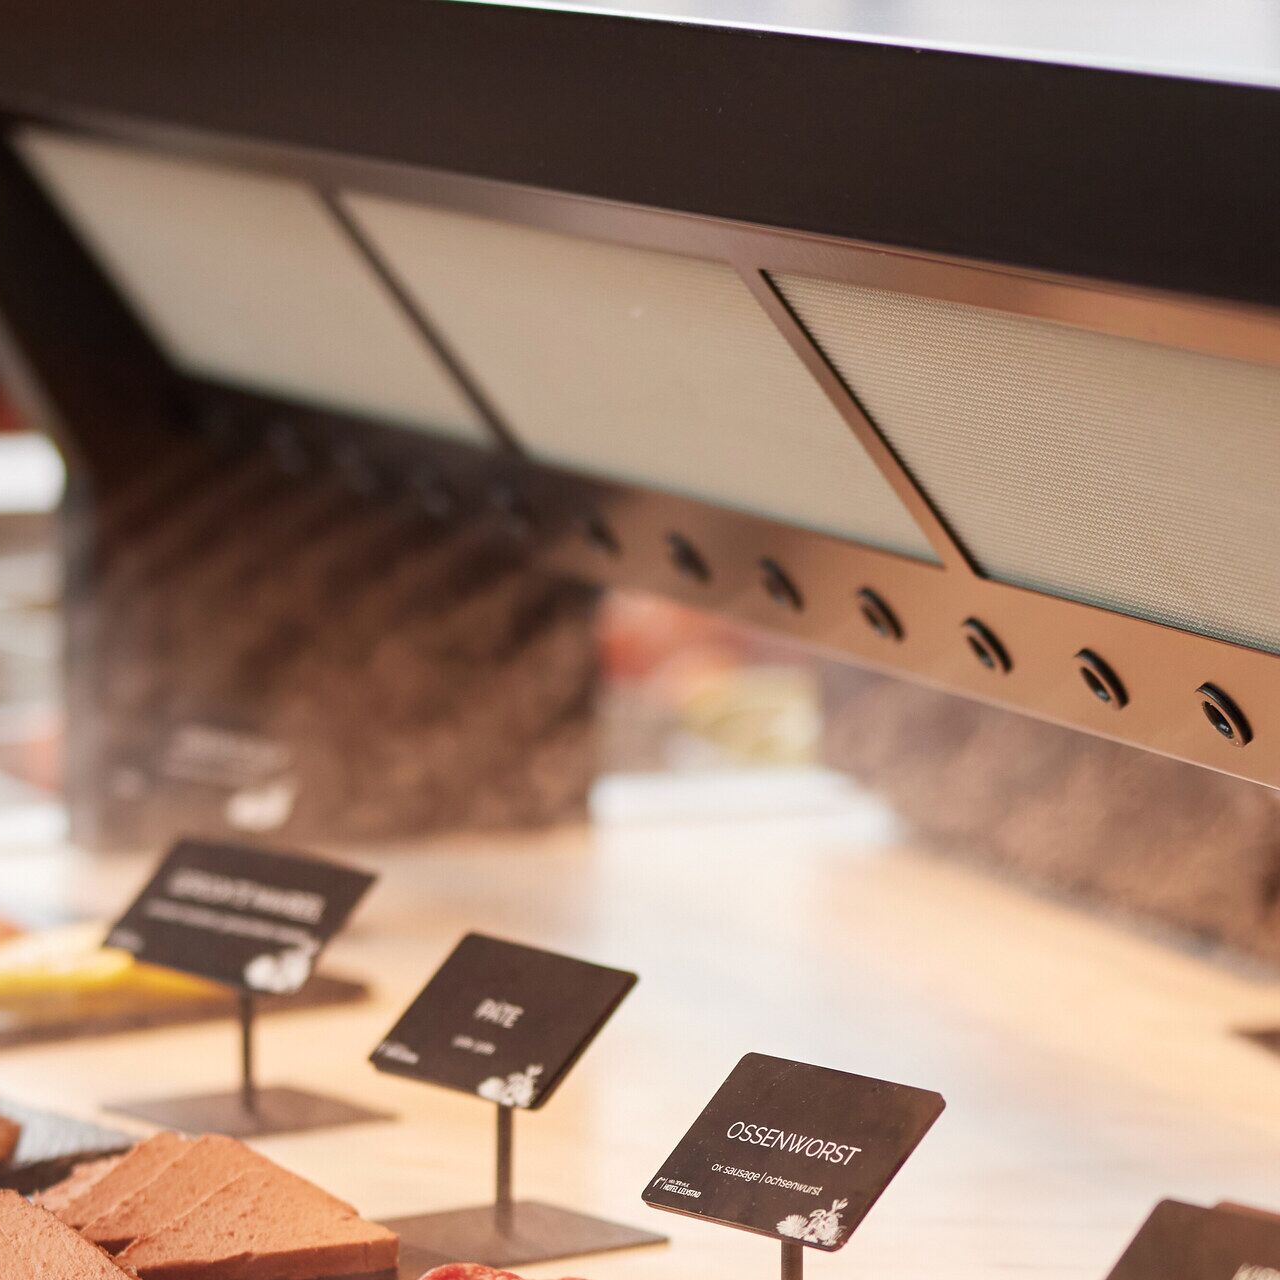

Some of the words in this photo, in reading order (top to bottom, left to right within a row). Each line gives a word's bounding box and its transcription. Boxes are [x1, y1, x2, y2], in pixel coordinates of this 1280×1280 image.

[726, 1121, 862, 1165] OSSENWORST
[711, 1163, 723, 1172] ox
[723, 1165, 761, 1182] sausage
[765, 1175, 823, 1196] ochsenwurst
